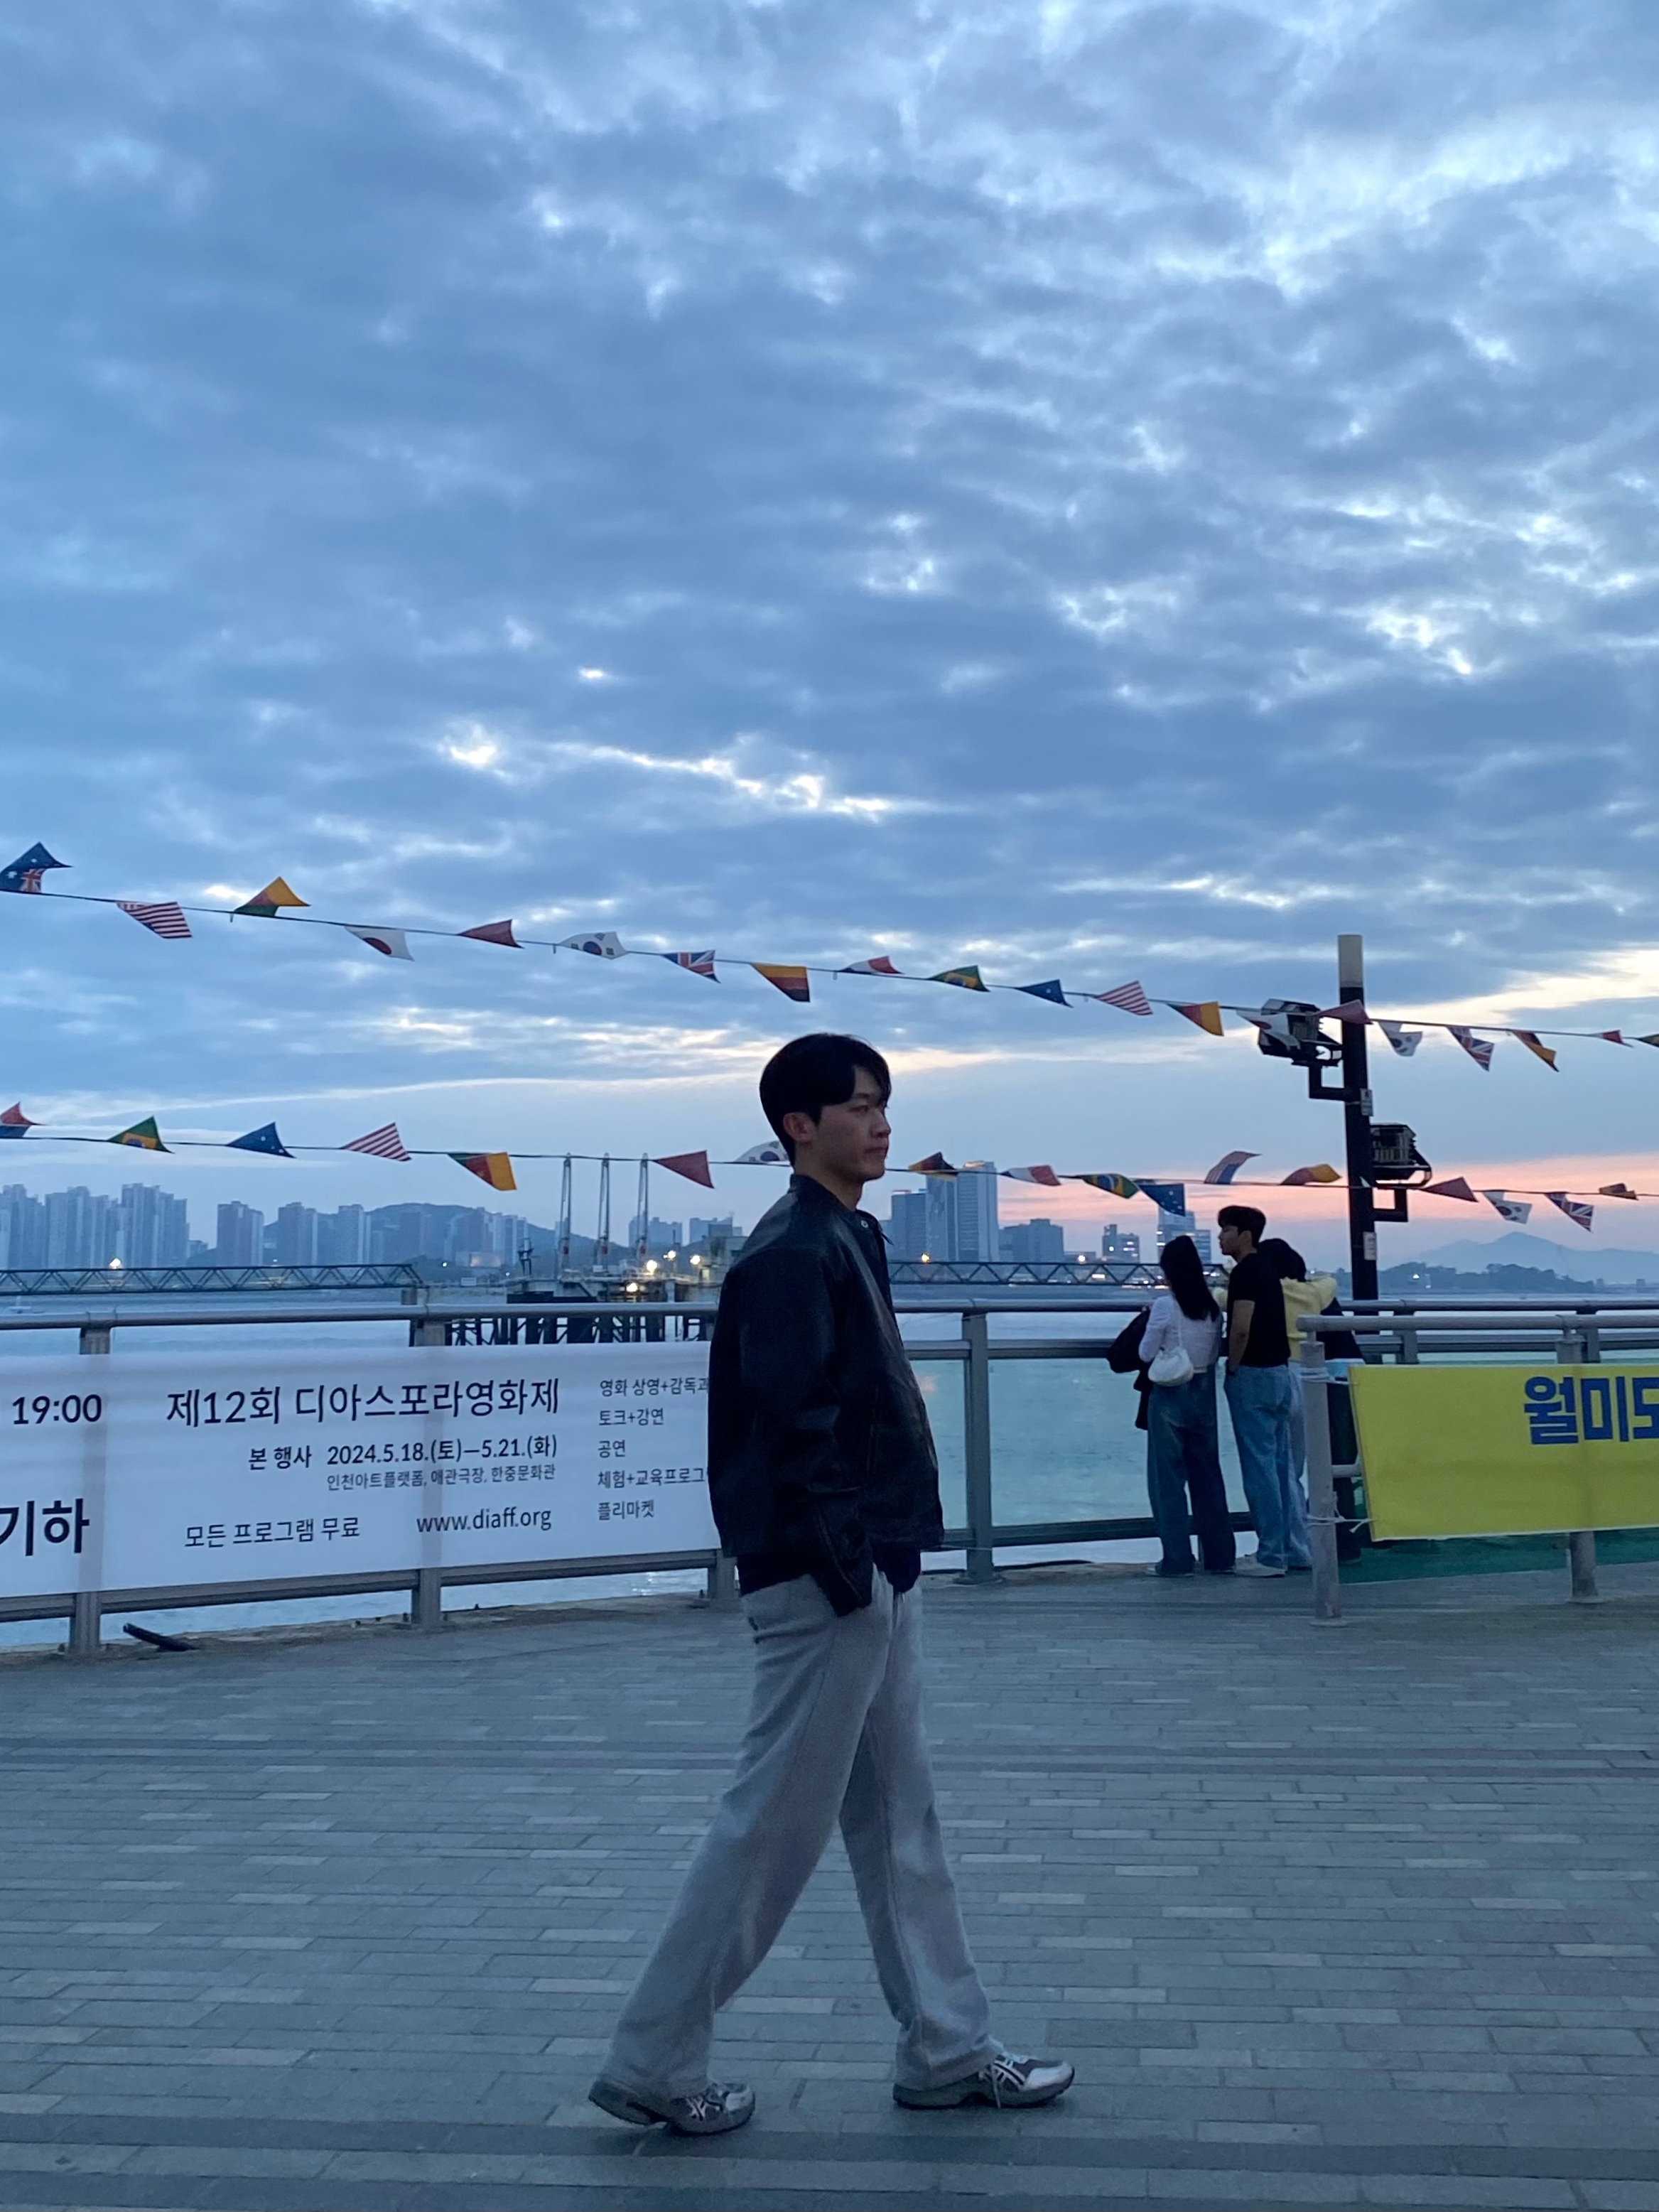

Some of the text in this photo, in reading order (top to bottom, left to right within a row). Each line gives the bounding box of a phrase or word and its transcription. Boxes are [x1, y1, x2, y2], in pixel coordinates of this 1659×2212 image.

[600, 1379, 627, 1397] 영화
[12, 1394, 103, 1425] 19:00
[166, 1378, 559, 1428] 제12회 디아스포라영화제
[598, 1408, 664, 1426] 토크+강연
[598, 1440, 626, 1459] 공연
[492, 1464, 556, 1483] 한중문화관
[416, 1506, 552, 1533] www.diaff.org
[598, 1499, 655, 1521] 플리마켓
[0, 1498, 90, 1556] 기하
[185, 1517, 361, 1548] 모든 프로그램 무료
